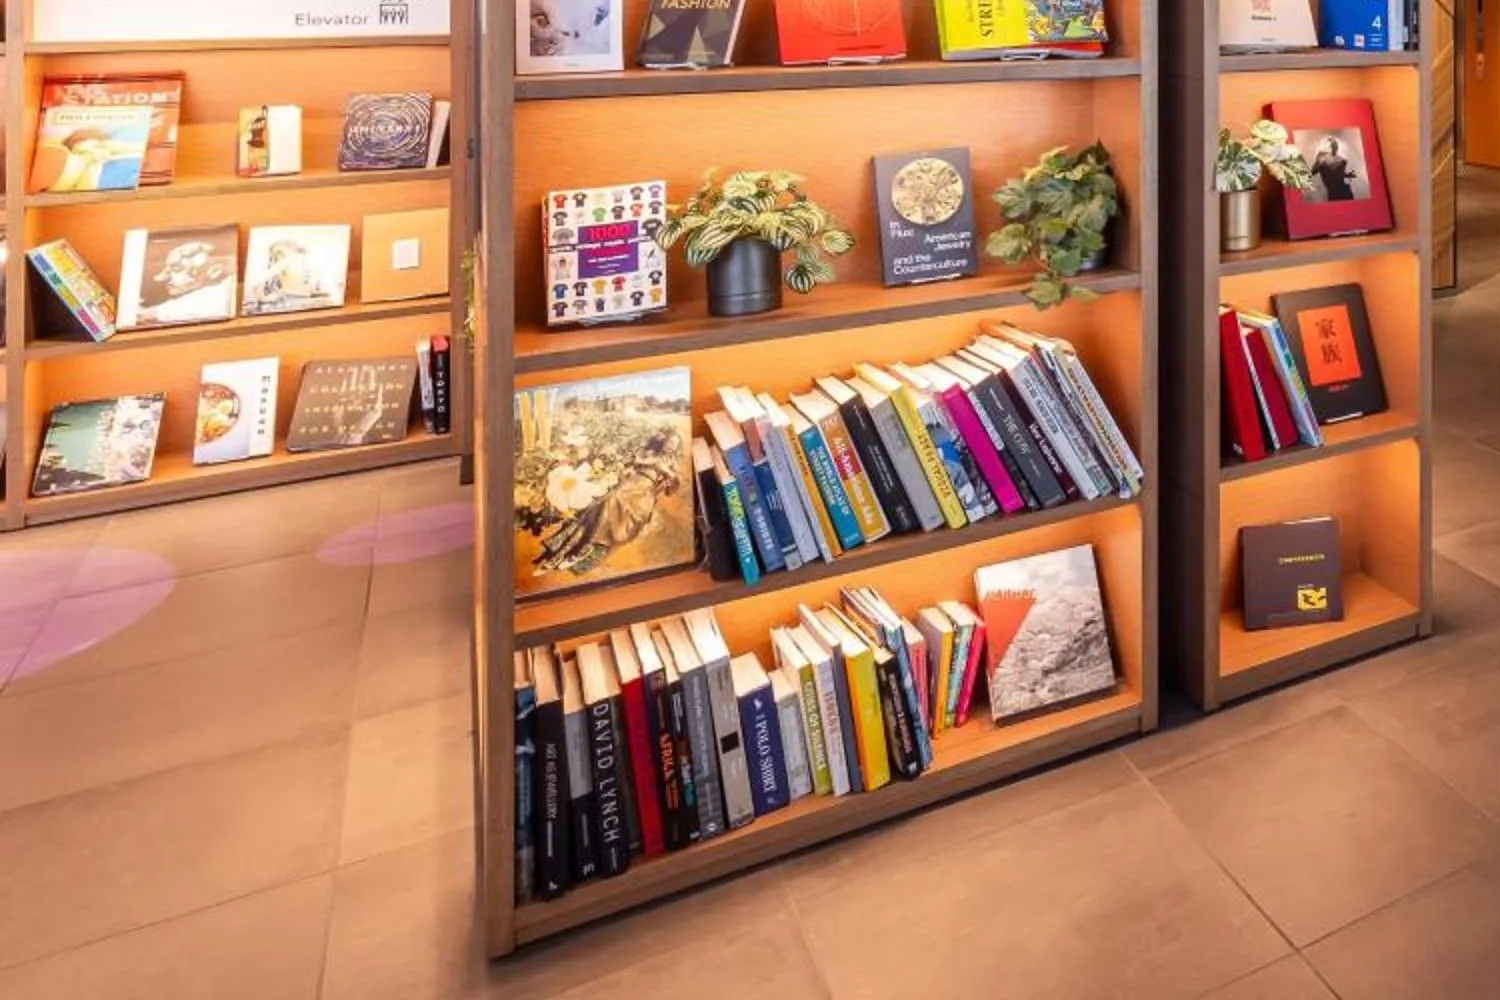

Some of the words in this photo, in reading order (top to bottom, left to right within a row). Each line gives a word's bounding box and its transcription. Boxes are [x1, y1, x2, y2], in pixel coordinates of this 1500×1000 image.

[295, 13, 370, 27] Elevator
[1371, 15, 1382, 29] 4
[924, 231, 971, 244] American
[893, 255, 914, 265] and
[915, 254, 931, 262] the
[893, 259, 969, 275] Counterculture
[593, 703, 615, 769] DAVID
[600, 777, 620, 843] LYNCH
